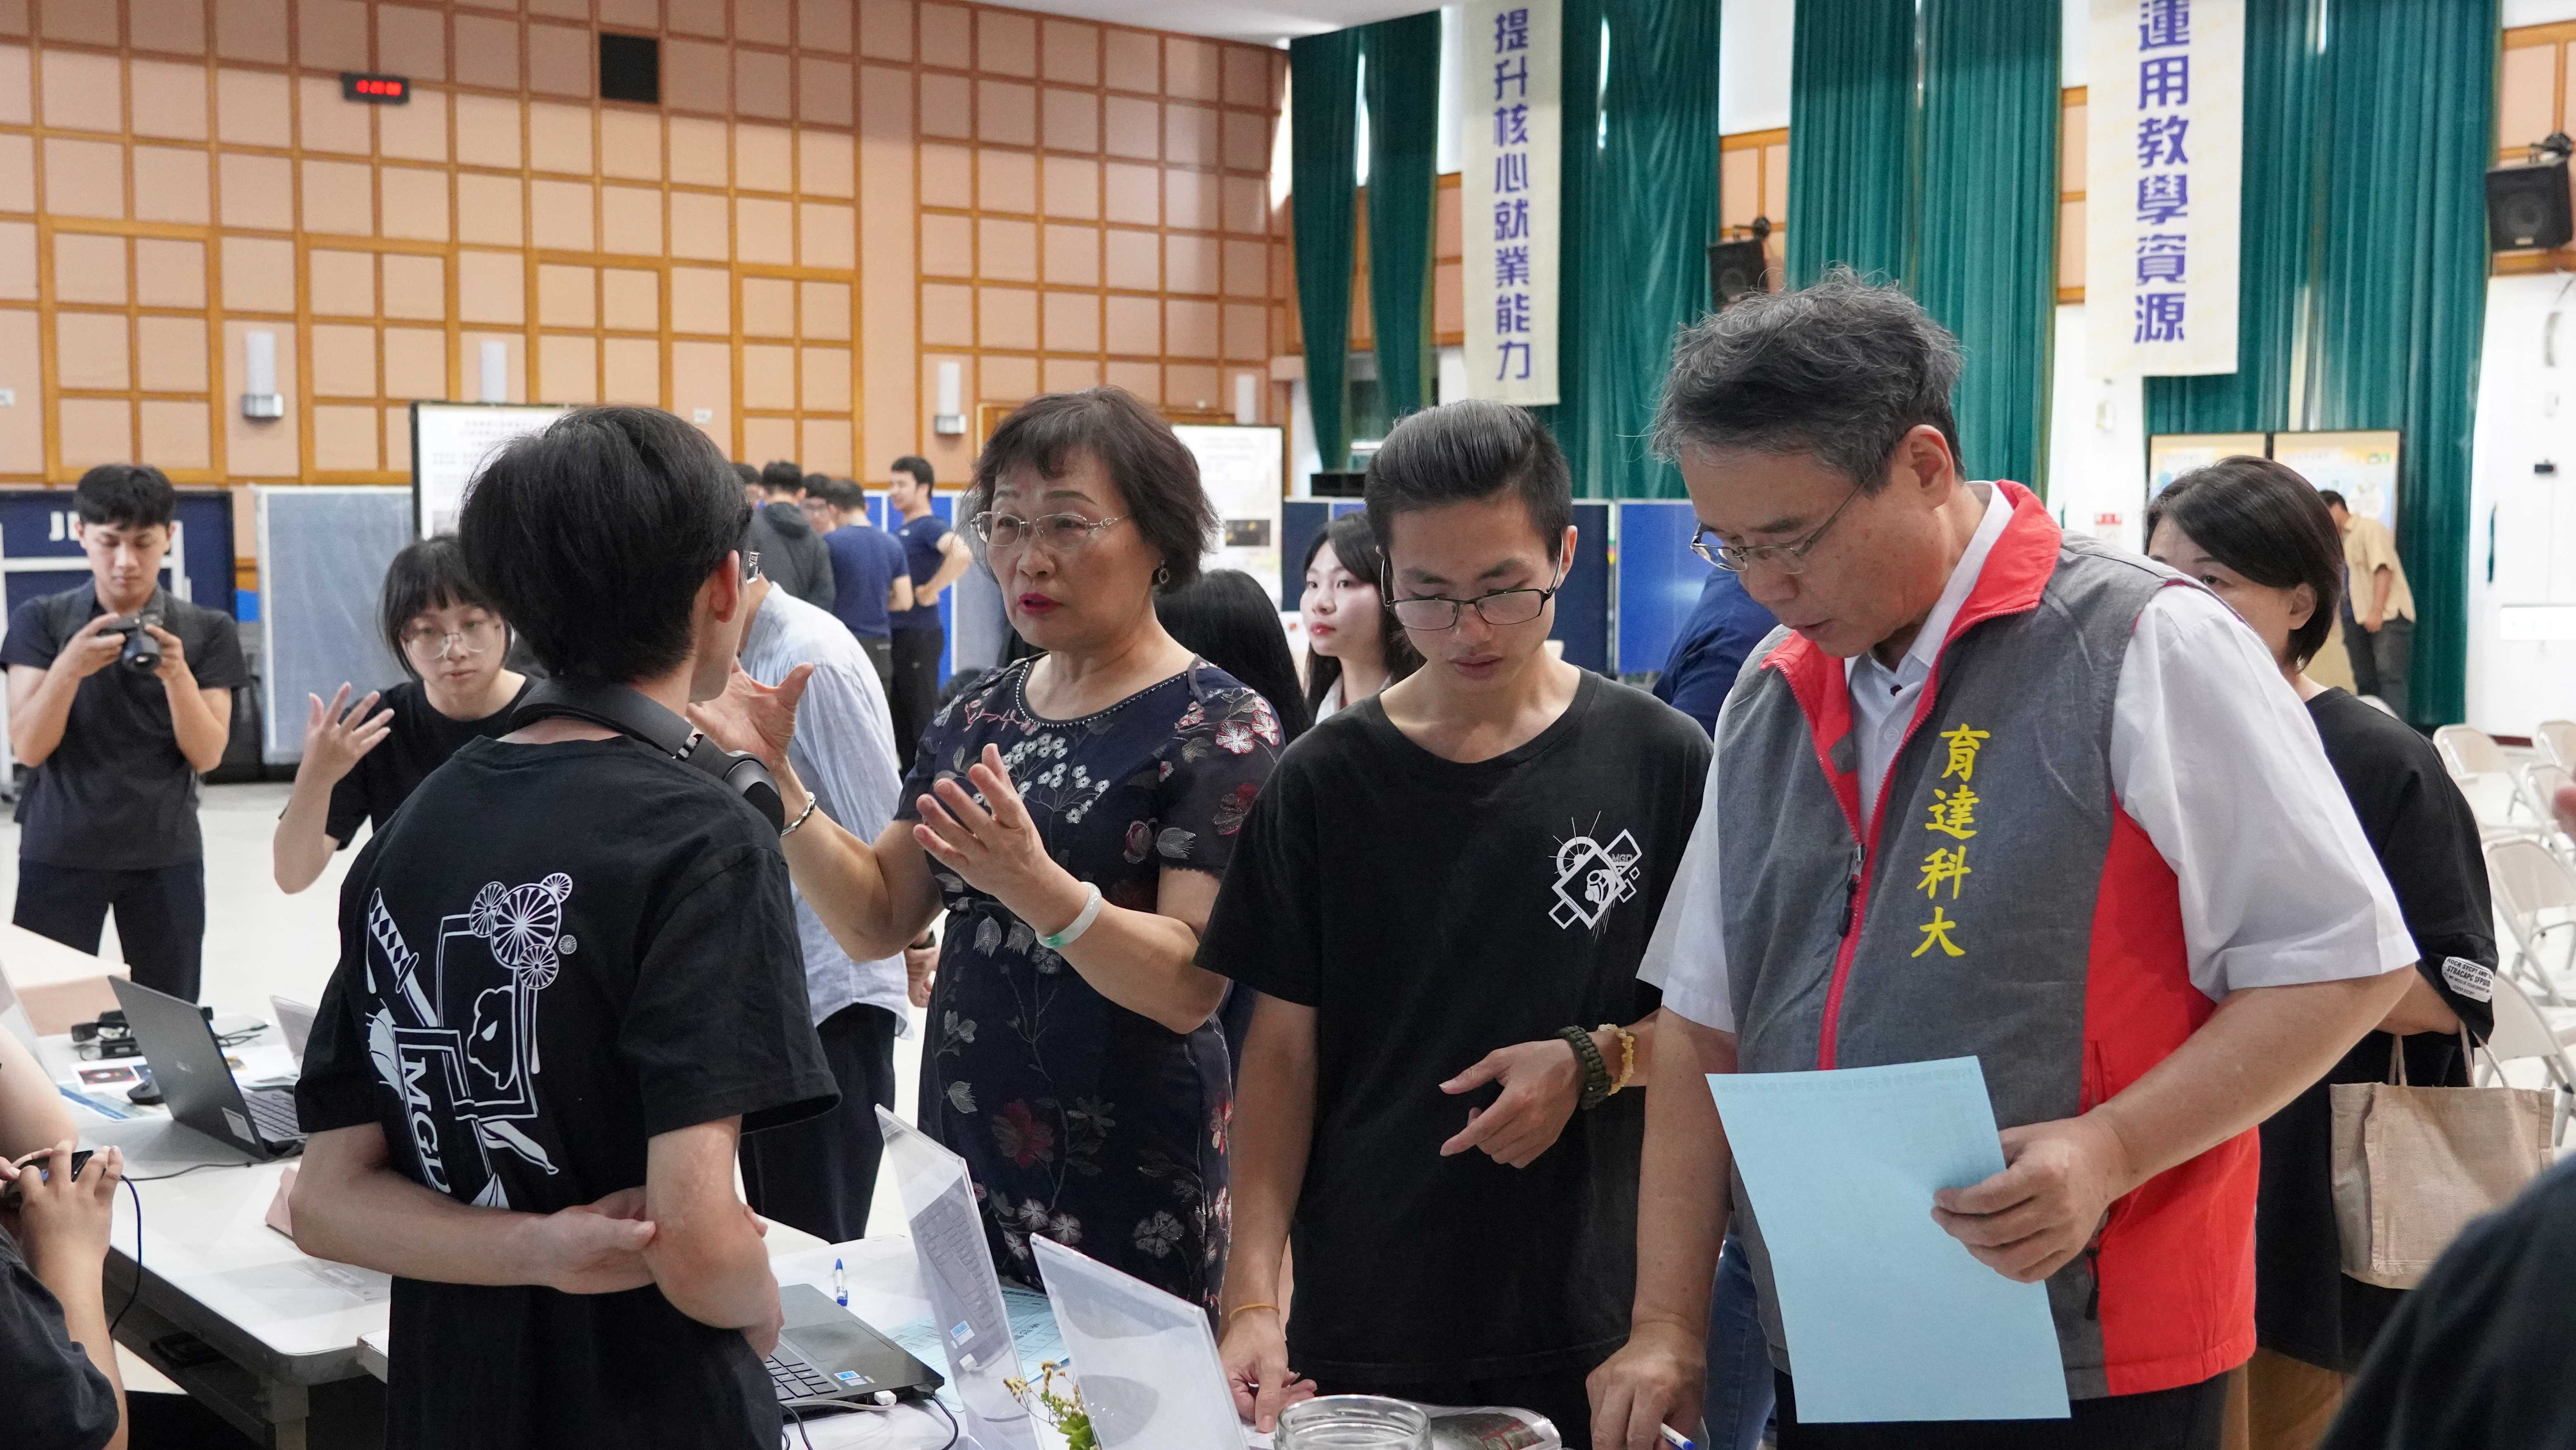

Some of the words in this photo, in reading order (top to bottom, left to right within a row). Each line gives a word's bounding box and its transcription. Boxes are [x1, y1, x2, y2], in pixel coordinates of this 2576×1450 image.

[1492, 8, 1532, 381] 提升核心就業能力
[2133, 0, 2190, 344] 運用教學資源
[1611, 853, 1633, 863] MGD
[1911, 723, 1991, 958] 育達科大
